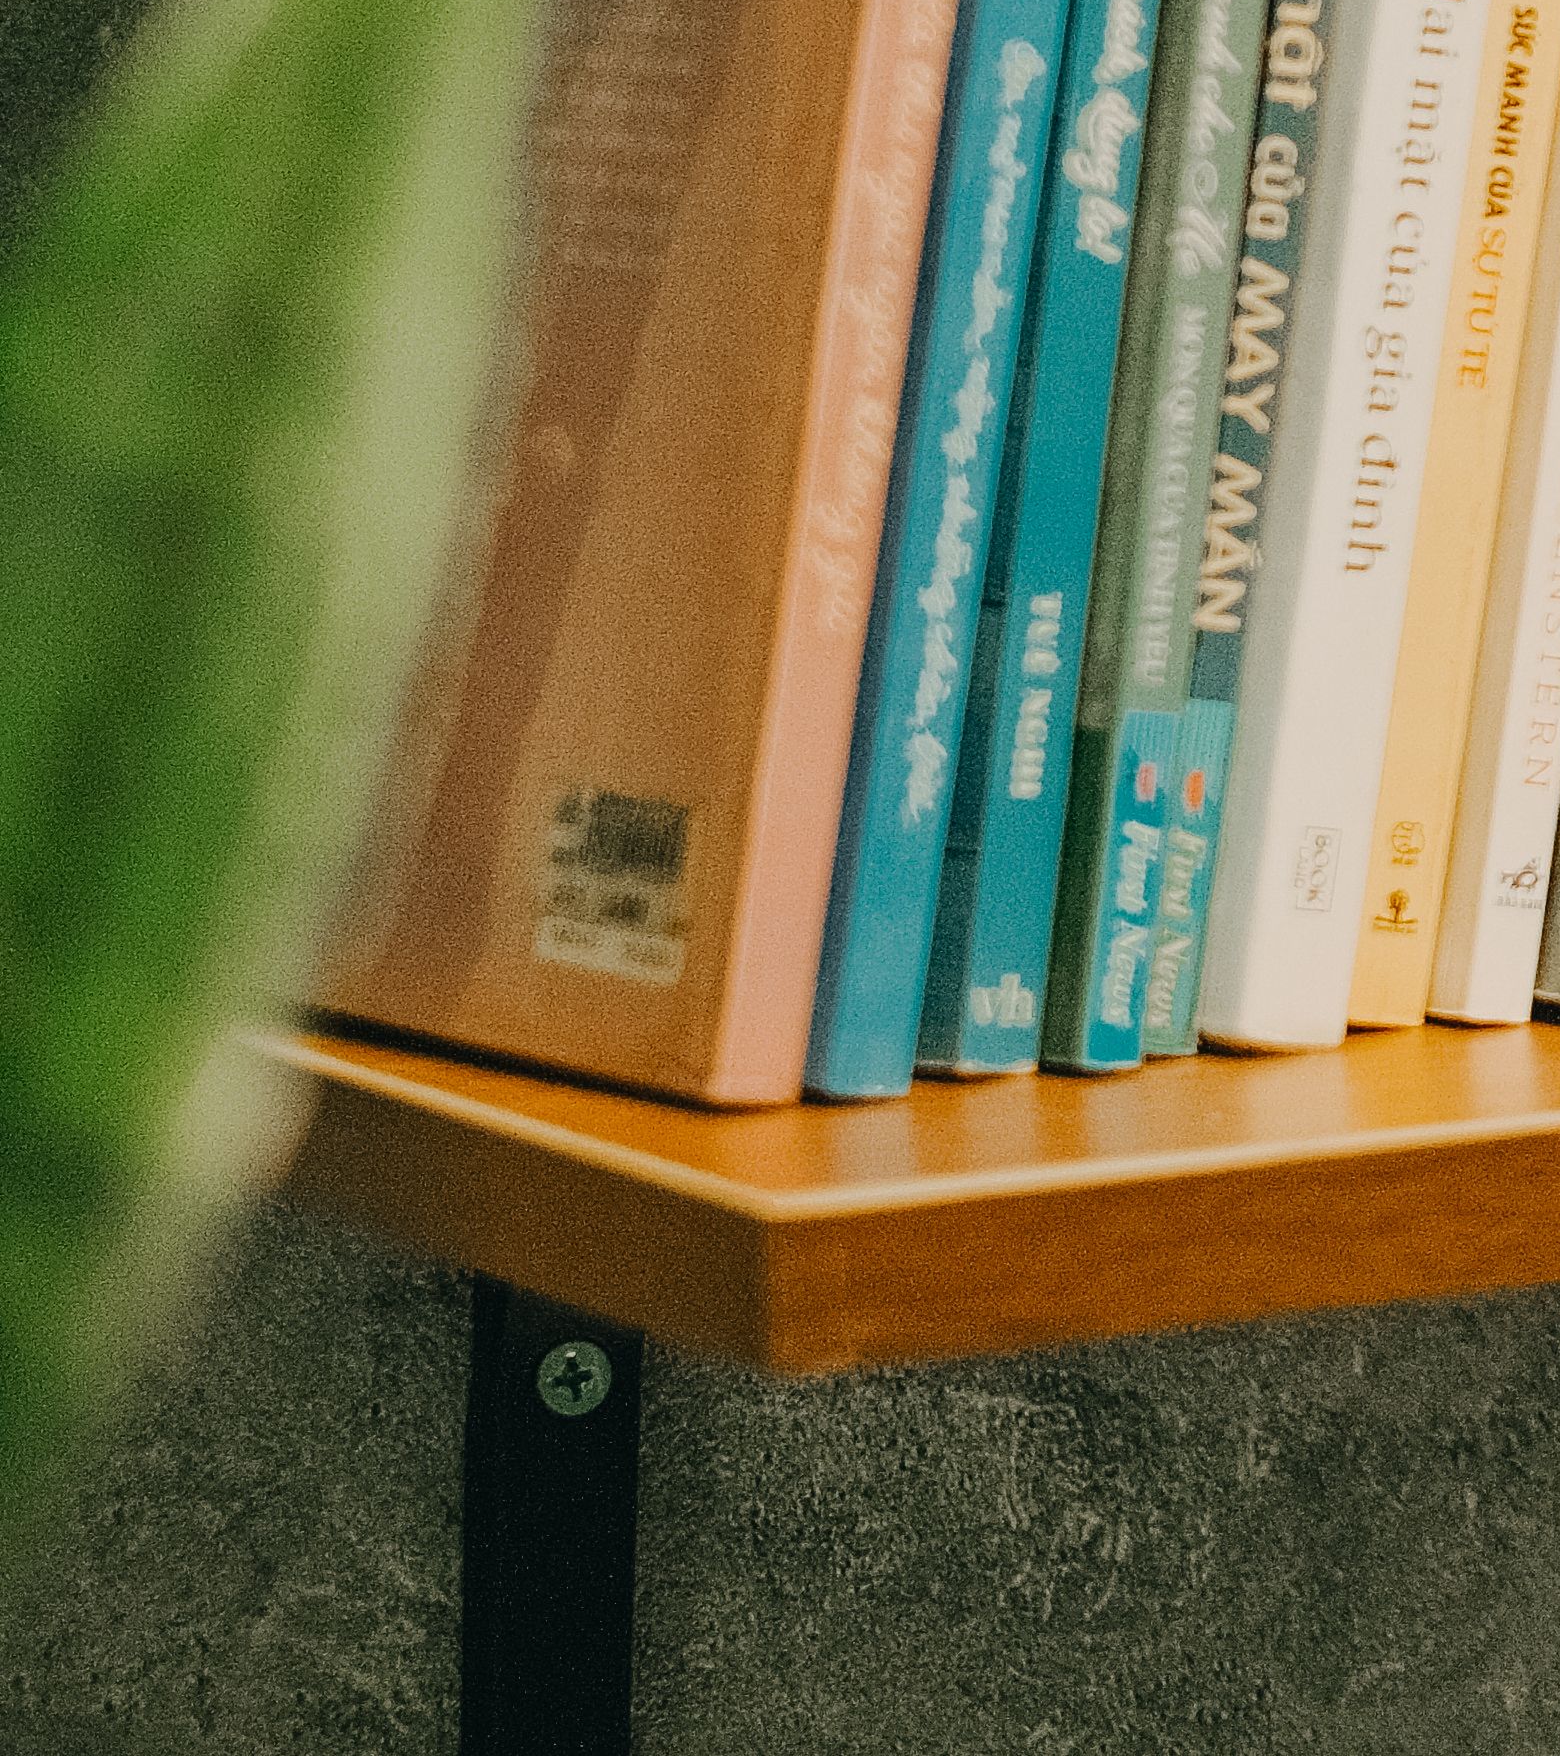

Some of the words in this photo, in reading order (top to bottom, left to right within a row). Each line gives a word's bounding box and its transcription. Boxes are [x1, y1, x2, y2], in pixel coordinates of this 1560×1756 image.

[1243, 131, 1302, 240] của
[1382, 74, 1453, 196] mặt
[1376, 206, 1437, 316] của
[1220, 256, 1287, 434] MAY
[1348, 323, 1419, 418] gia
[1196, 455, 1270, 637] MẮN
[1344, 434, 1398, 572] đình
[1116, 821, 1160, 913] First
[1163, 829, 1207, 917] First
[1102, 921, 1147, 1026] News
[1146, 936, 1192, 1027] News
